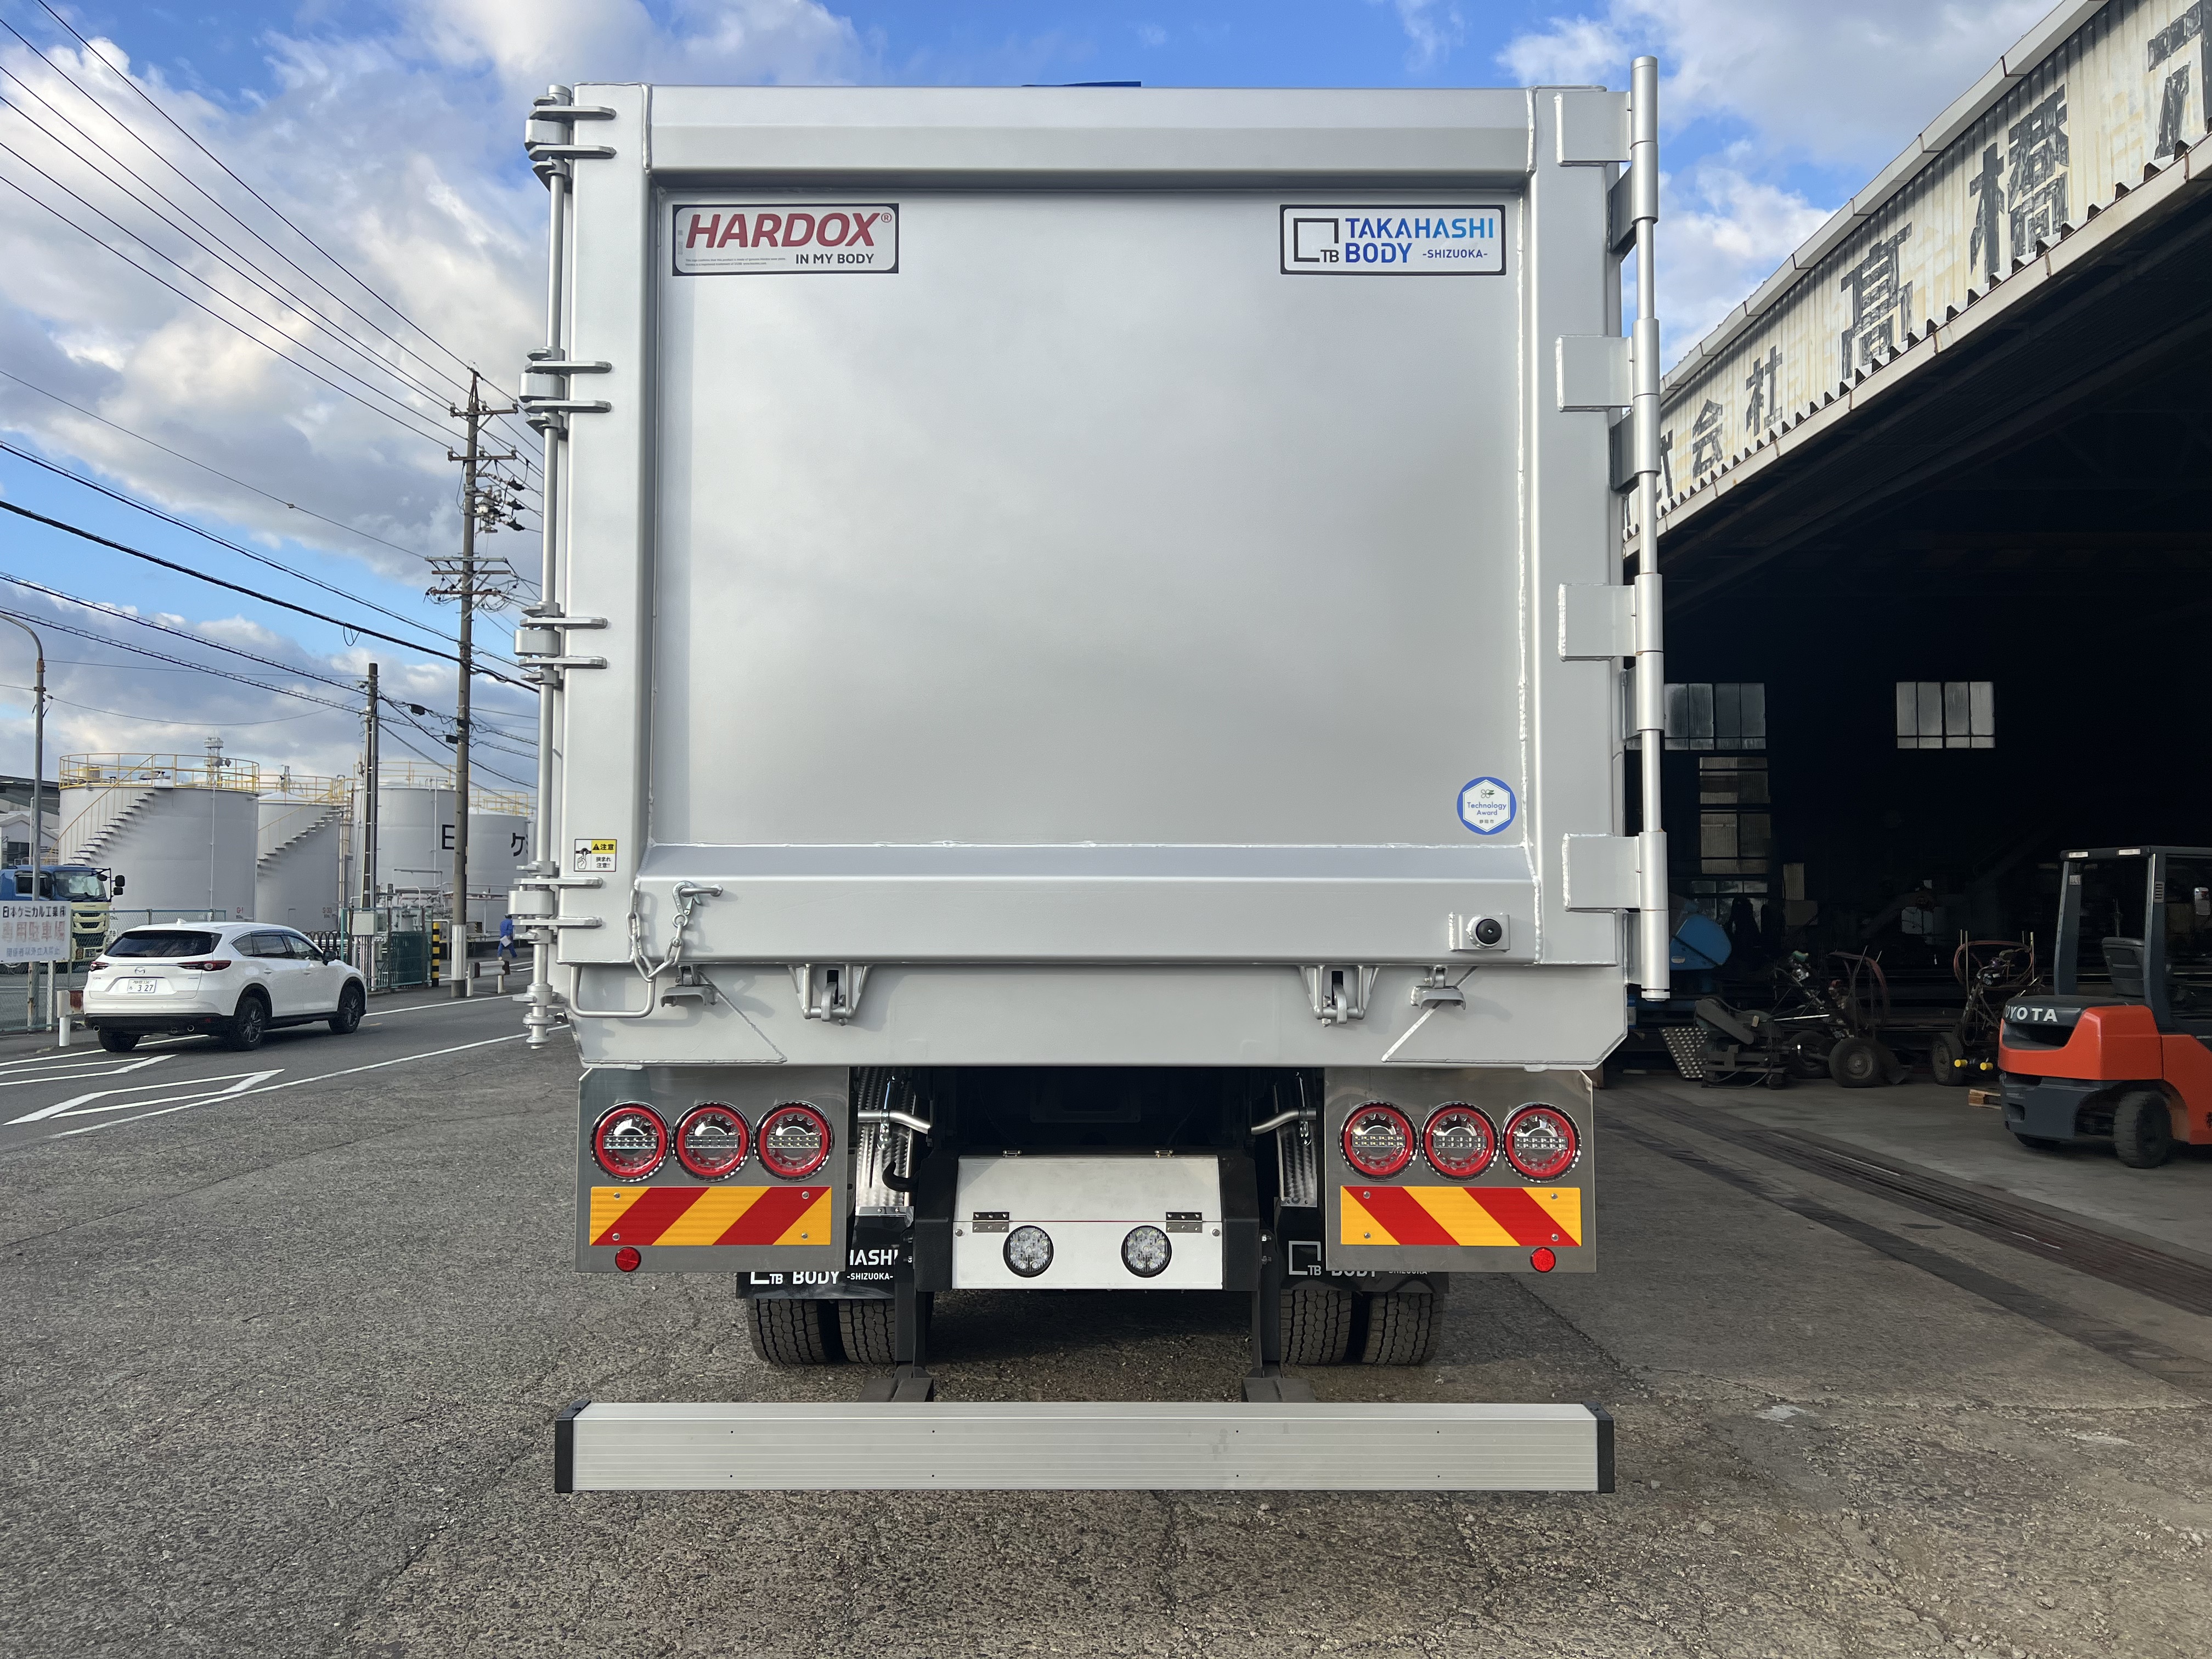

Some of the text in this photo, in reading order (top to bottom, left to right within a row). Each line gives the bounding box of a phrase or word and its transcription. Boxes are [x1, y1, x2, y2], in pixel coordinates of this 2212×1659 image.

[1345, 218, 1493, 238] TAKAHASHI
[796, 254, 811, 264] IN
[814, 254, 833, 264] MY
[837, 253, 874, 264] BODY
[1321, 243, 1488, 263] TB BODY -SHIZUOKA-
[1467, 802, 1506, 810] Technology
[793, 1271, 839, 1284] BODY
